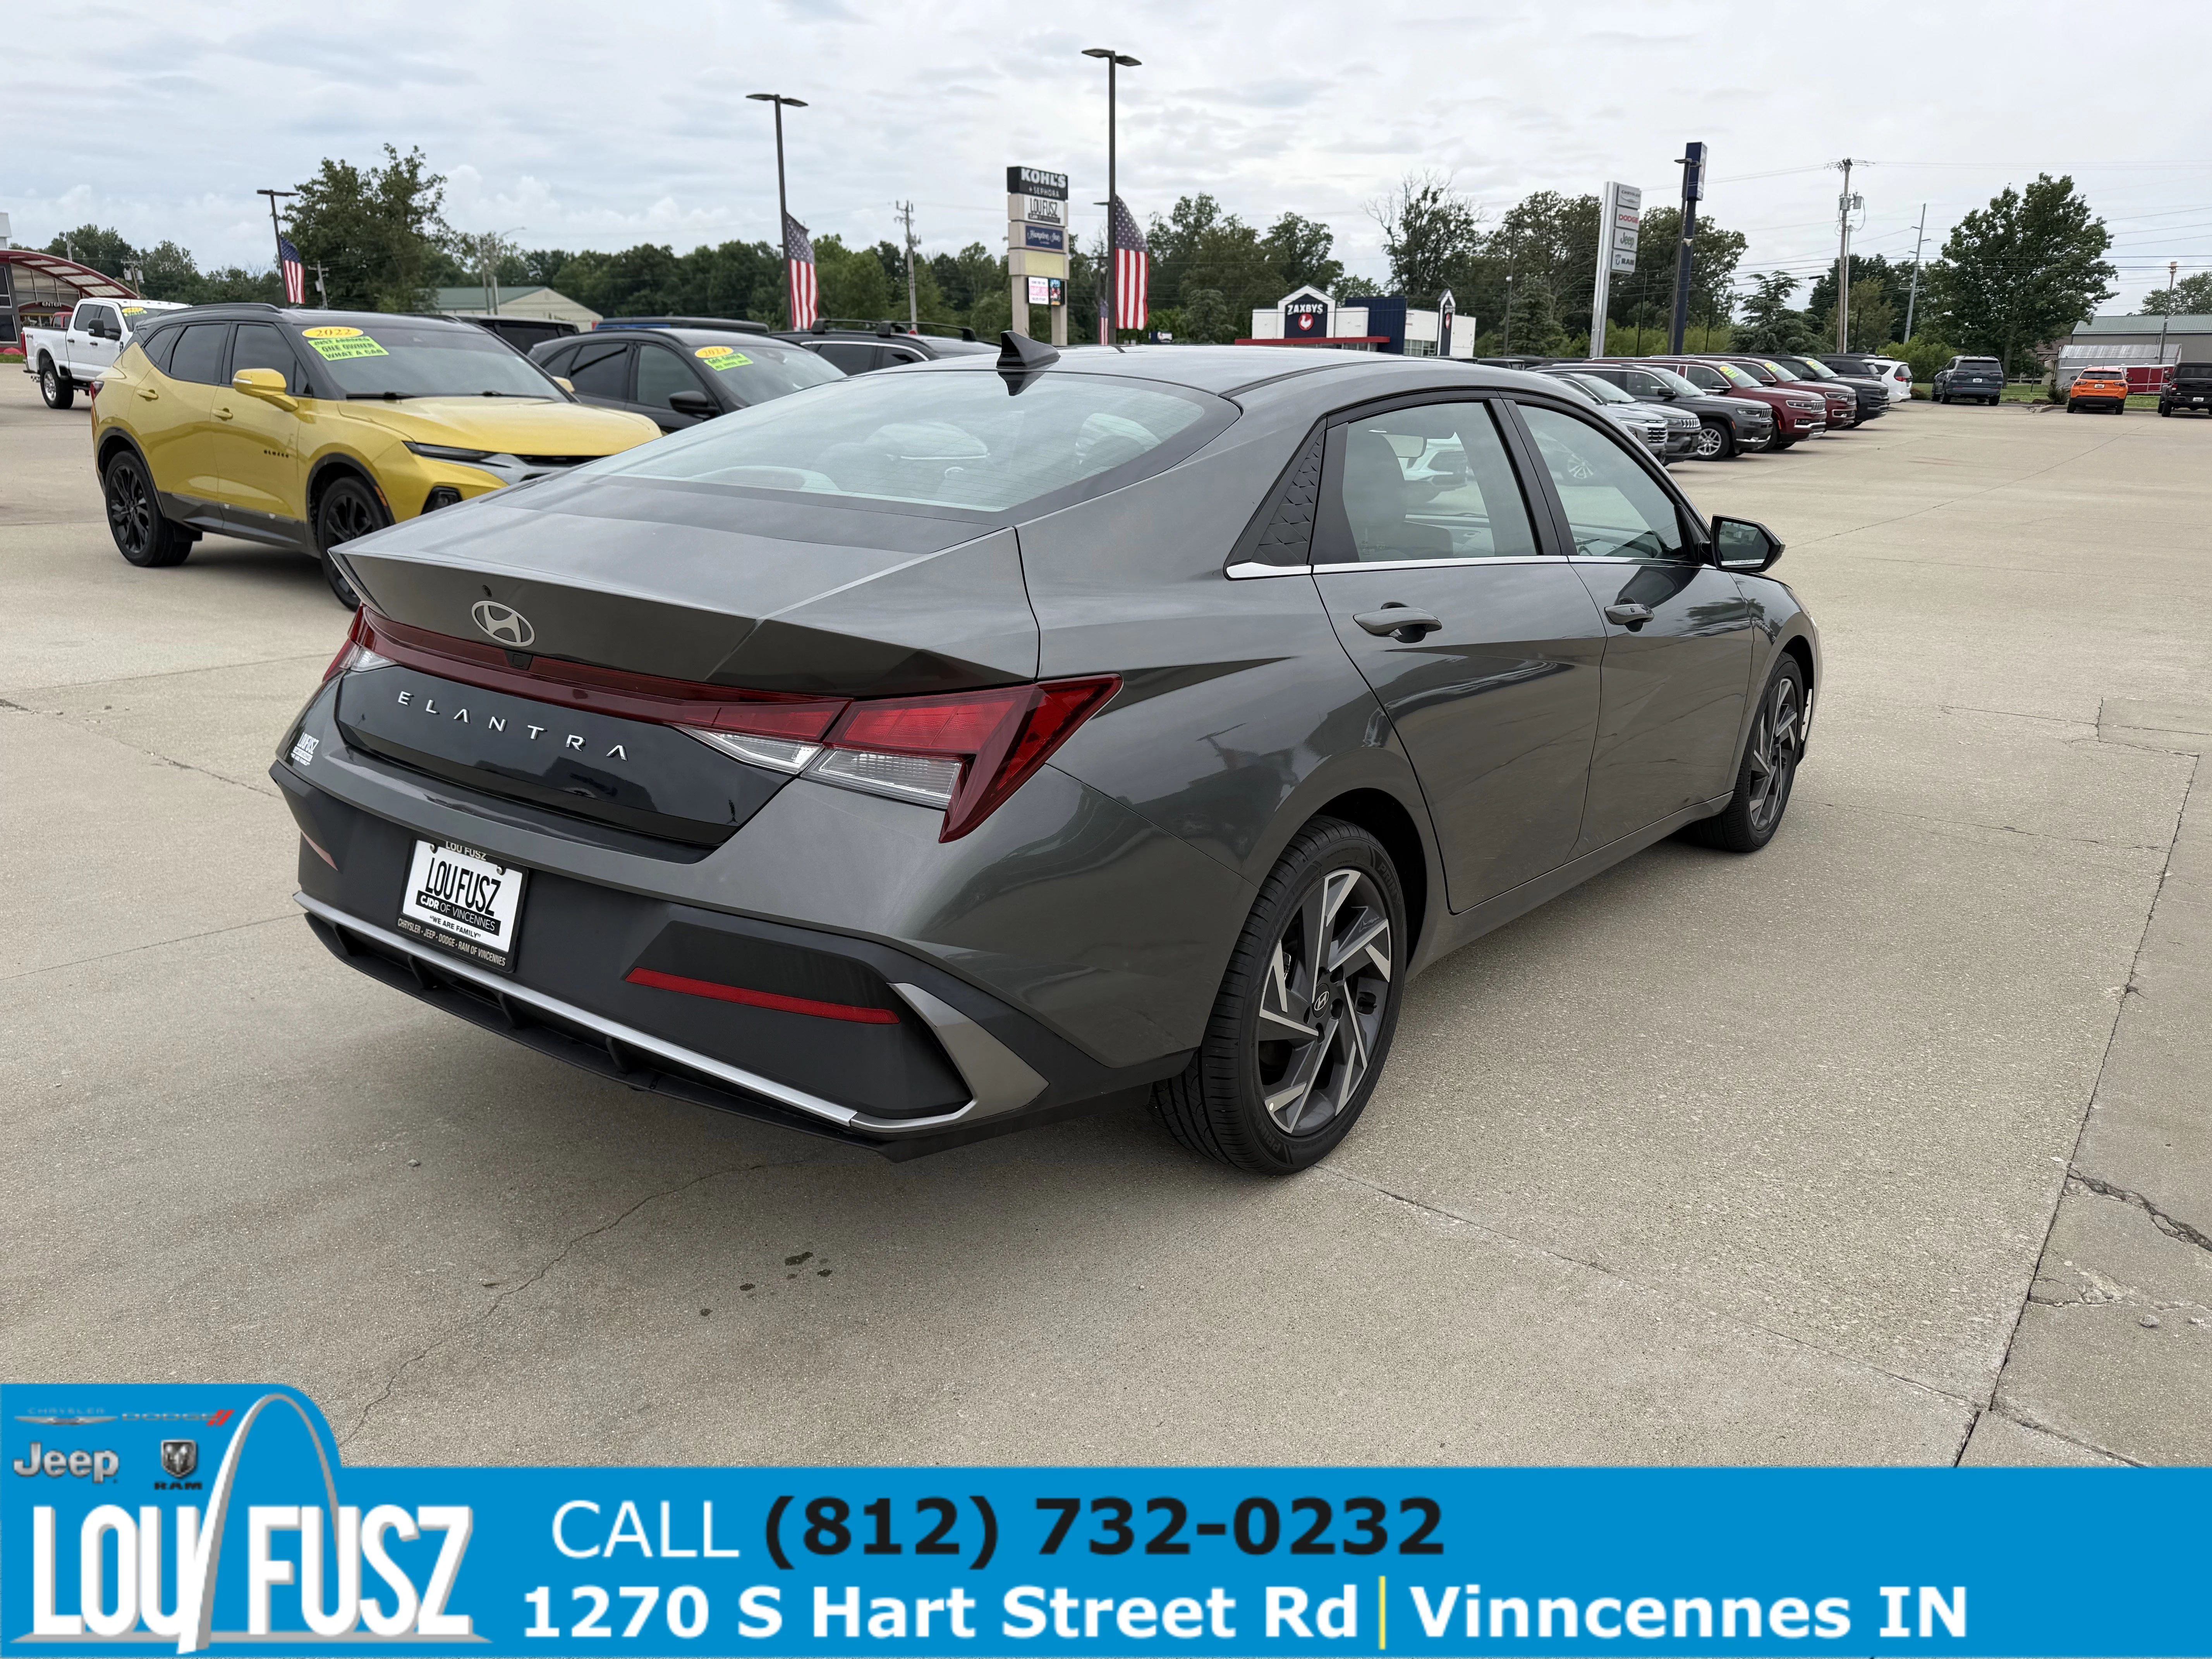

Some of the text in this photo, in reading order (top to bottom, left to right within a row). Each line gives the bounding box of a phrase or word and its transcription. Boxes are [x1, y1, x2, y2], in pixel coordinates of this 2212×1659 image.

[1021, 168, 1066, 188] KOHL'S
[1618, 214, 1639, 223] DODGE
[1620, 232, 1634, 248] Jeep
[1287, 304, 1324, 315] ZAXBYS
[398, 690, 628, 761] ELANTRA
[445, 841, 487, 861] LOU FUSZ
[425, 857, 501, 917] LOU FUSZ
[420, 895, 495, 931] CJDR OF VINCENNES
[442, 920, 455, 930] ARE
[397, 918, 506, 967] CHRYSLER JEEP DODGE RAM OF VINCENNES
